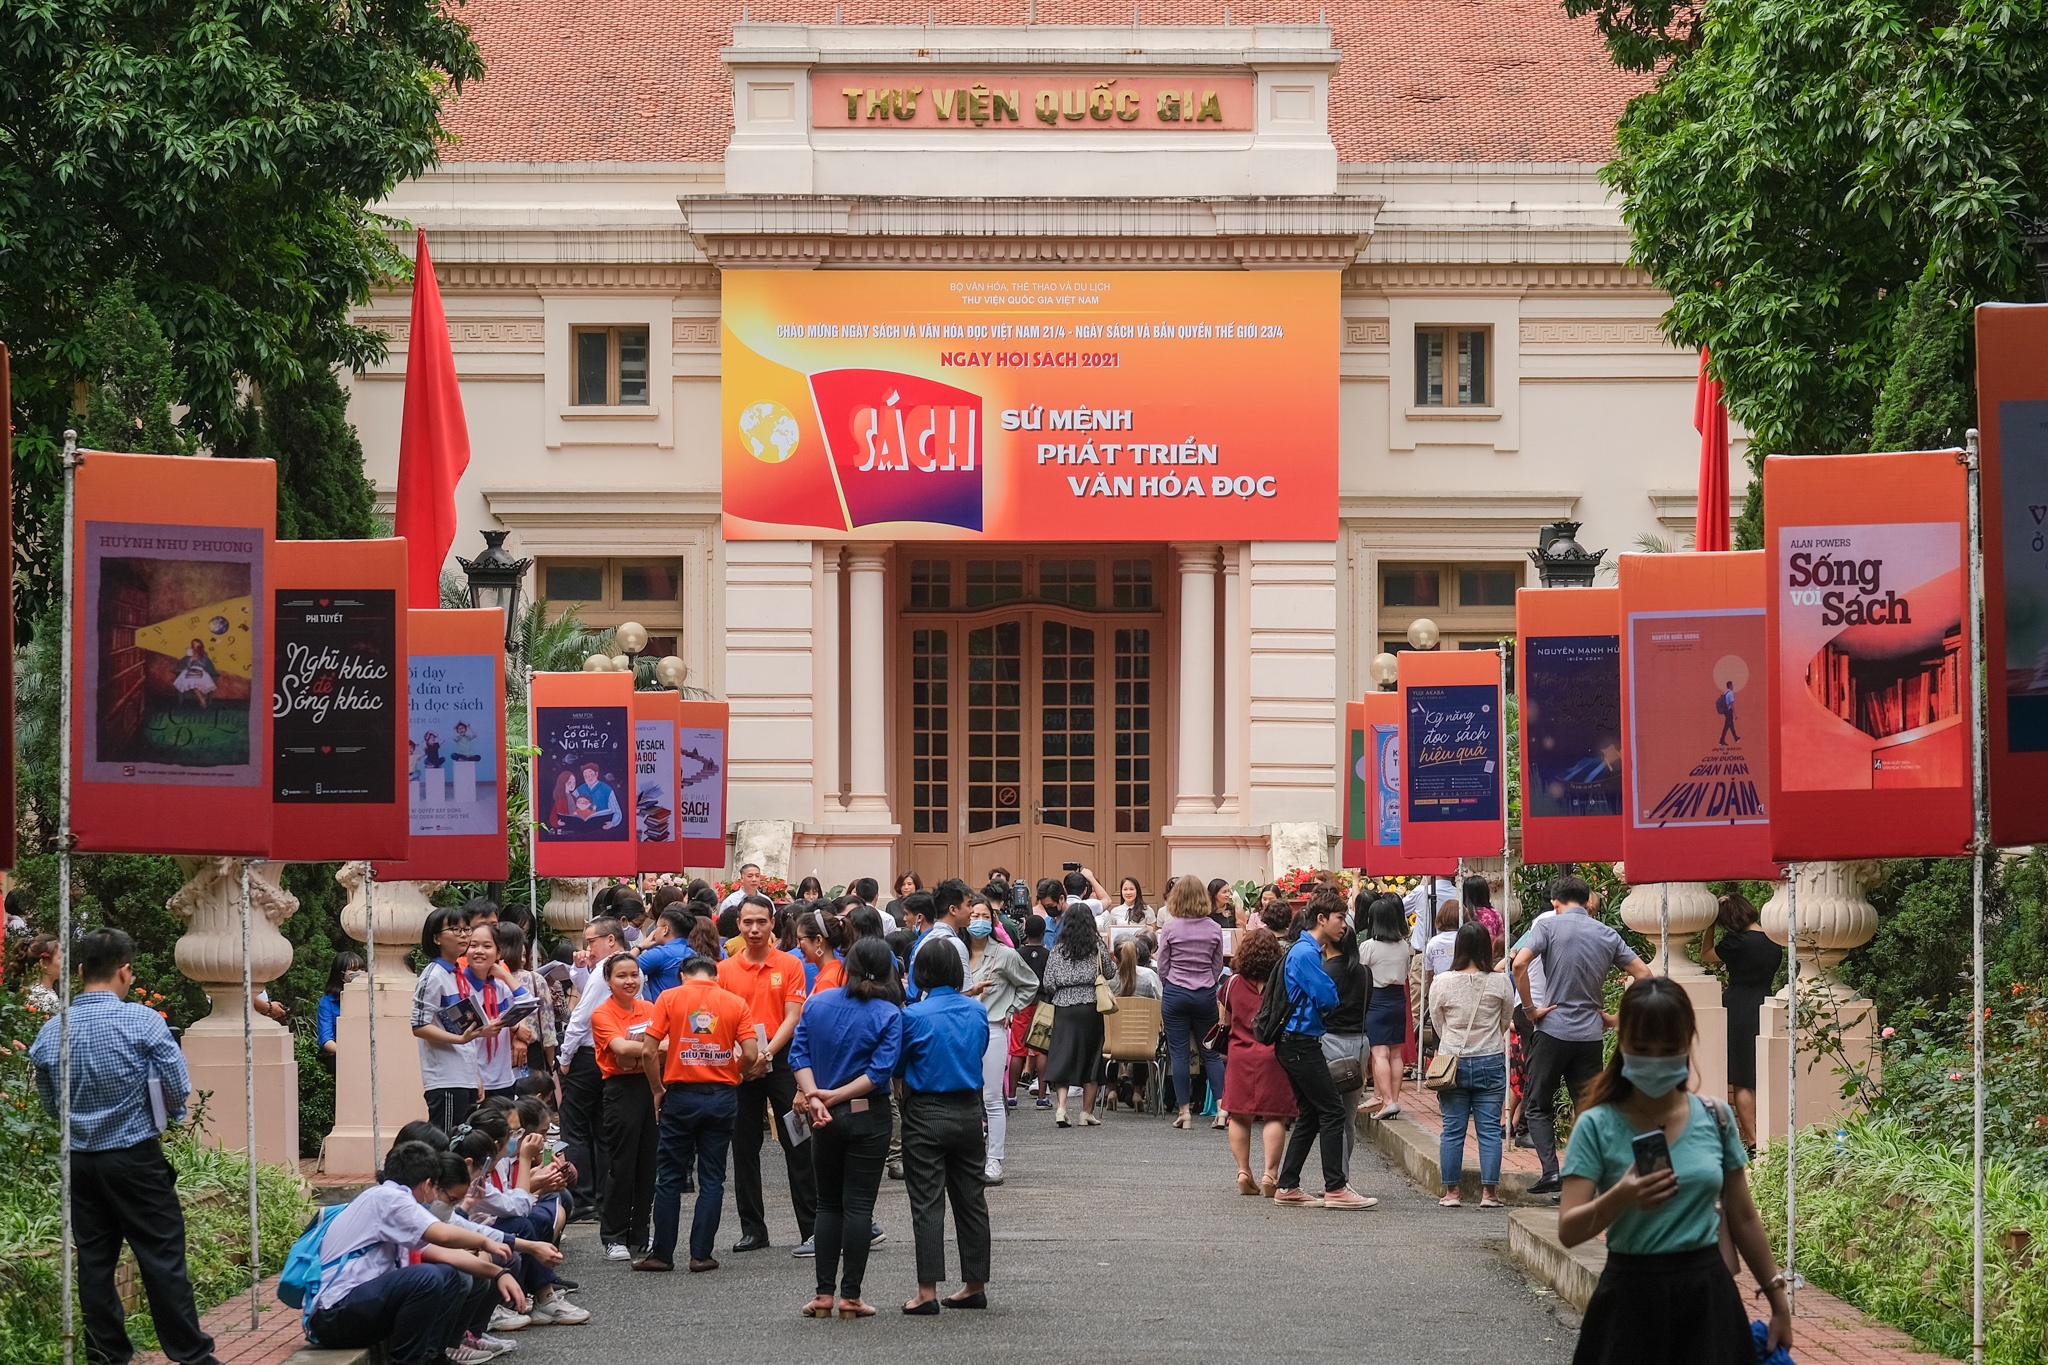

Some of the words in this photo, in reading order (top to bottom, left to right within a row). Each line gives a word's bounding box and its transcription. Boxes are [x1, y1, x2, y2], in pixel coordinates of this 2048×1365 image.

[842, 86, 922, 120] THƯ
[932, 82, 1019, 127] VIỆN
[1035, 79, 1140, 125] QUỐC
[1156, 89, 1224, 122] GIA
[966, 282, 985, 291] VĂN
[987, 281, 1009, 292] HÓA,
[1031, 283, 1057, 291] THAO
[1057, 281, 1073, 291] VÀ
[1074, 283, 1088, 291] DU
[1089, 283, 1111, 293] LỊCH
[962, 295, 982, 304] THƯ
[984, 295, 1005, 305] VIỆN
[1037, 296, 1054, 304] GIA
[1056, 295, 1076, 305] VIỆT
[1078, 296, 1099, 304] NAM
[777, 322, 805, 338] CHÀO
[841, 323, 869, 338] NGÀY
[872, 322, 900, 338] SÁCH
[903, 323, 917, 338] VÀ
[919, 322, 941, 338] VĂN
[944, 322, 965, 338] HÓA
[967, 325, 988, 341] ĐỌC
[991, 323, 1014, 341] VIỆT
[1015, 325, 1040, 339] NAM
[1043, 325, 1066, 339] 21/4
[1075, 323, 1104, 339] NGÀY
[1107, 322, 1134, 339] SÁCH
[1137, 323, 1151, 338] VÀ
[1154, 322, 1175, 338] BẢN
[1178, 322, 1213, 339] QUYỀN
[1215, 322, 1235, 338] THẾ
[1237, 322, 1259, 338] GIỚI
[1260, 325, 1284, 339] 23/4
[1081, 352, 1120, 368] 2021
[1000, 403, 1044, 430] SỨ
[1049, 404, 1134, 435] MỆNH
[849, 386, 976, 472] SÁCH
[1037, 437, 1123, 465] PHÁT
[1126, 435, 1219, 465] TRIỂN
[1067, 471, 1134, 497] VĂN
[1139, 469, 1206, 497] HÓA
[1211, 475, 1278, 501] ĐỌC
[99, 534, 153, 549] HUỲNH
[1790, 540, 1813, 549] ALAN
[1815, 538, 1851, 548] POWERS
[1789, 552, 1883, 595] Sống
[1790, 586, 1822, 606] với
[1822, 590, 1912, 626] Sách
[305, 614, 319, 623] PHI
[319, 612, 344, 623] TUYẾT
[1577, 646, 1604, 656] MẠNH
[286, 642, 340, 684] Nghĩ
[338, 655, 389, 680] khác
[423, 666, 447, 682] dạy
[446, 682, 465, 695] trẻ
[272, 673, 330, 724] Sống
[333, 686, 384, 710] khác
[453, 697, 484, 711] sách
[1424, 710, 1444, 728] Kỹ
[1445, 710, 1476, 726] năng
[563, 729, 577, 739] Có
[1423, 728, 1450, 746] đọc
[1455, 724, 1491, 743] sách
[1419, 744, 1455, 764] hiệu
[1457, 740, 1487, 766] quả
[1689, 763, 1723, 777] GIAN
[1723, 763, 1750, 775] NAN
[1648, 782, 1709, 828] VẠN
[1705, 776, 1764, 826] DẶM
[680, 1050, 698, 1059] SIÊU
[699, 1050, 713, 1059] TRÍ
[714, 1050, 732, 1059] NHỚ
